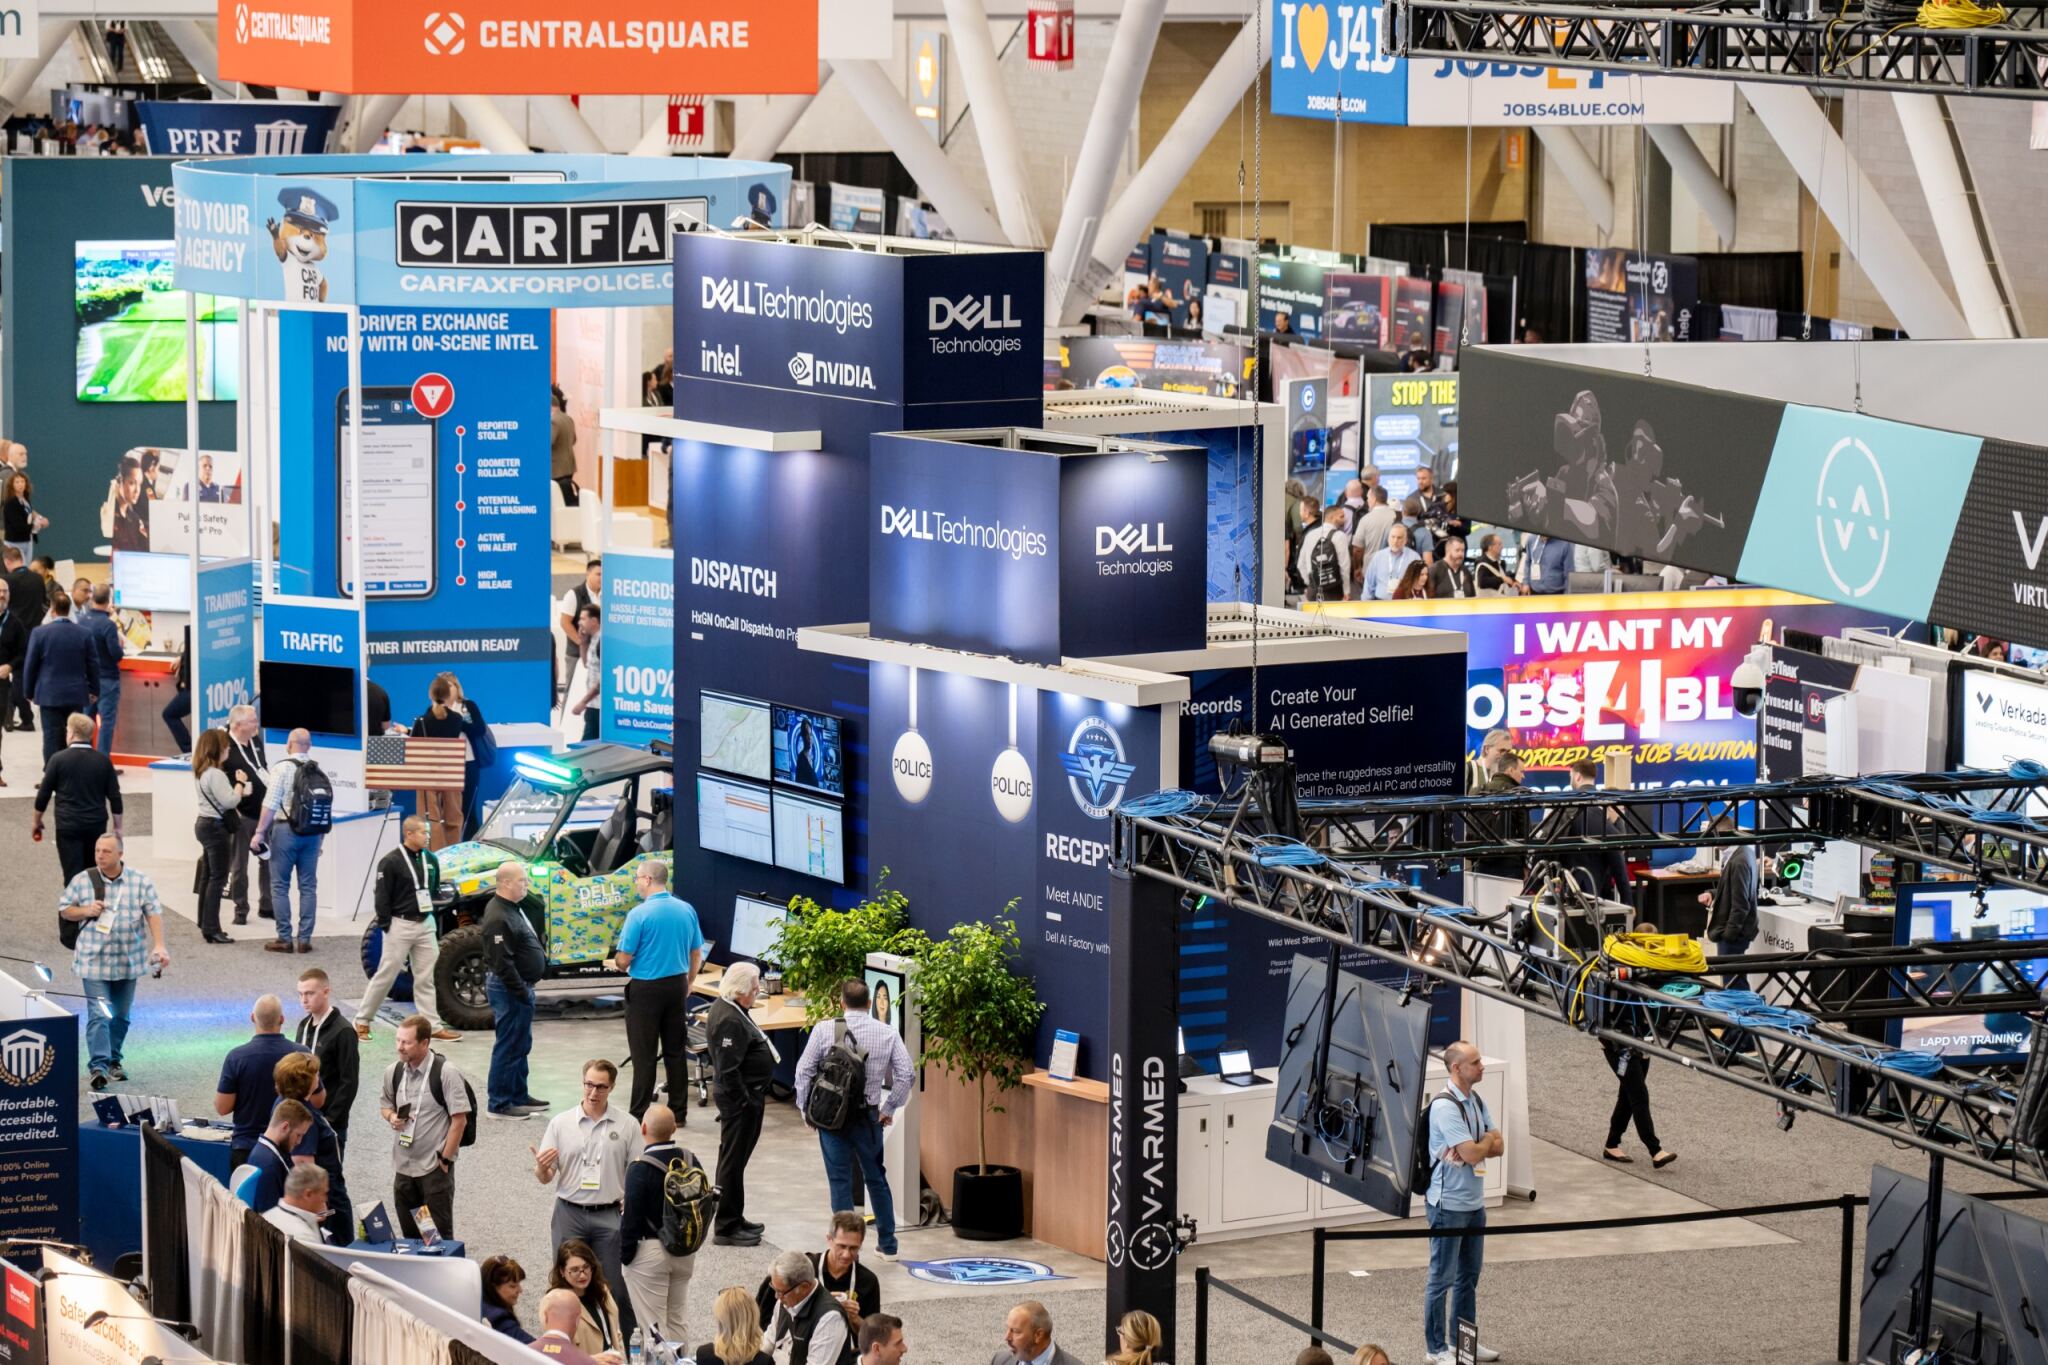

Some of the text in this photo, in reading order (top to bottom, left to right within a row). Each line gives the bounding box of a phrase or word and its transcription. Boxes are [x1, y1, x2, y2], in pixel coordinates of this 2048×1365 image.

[251, 11, 331, 46] CENTRALSQUARE
[480, 20, 750, 54] CENTRALSQUARE
[1503, 103, 1645, 117] JOBS4BLUE.COM
[167, 127, 242, 155] PERF
[184, 199, 249, 235] TO YOUR
[184, 237, 246, 273] AGENCY
[702, 276, 873, 334] DELL Technologies
[928, 294, 1022, 331] DELL
[422, 313, 509, 332] EXCHANGE
[1678, 309, 1691, 339] help
[367, 334, 407, 352] WITH
[412, 334, 492, 352] ON-SCENE
[495, 334, 538, 351] INTEL
[928, 335, 1022, 356] Technologies
[1392, 380, 1456, 406] STOP THE
[477, 421, 518, 431] REPORTED
[477, 431, 508, 440] STOLEN
[477, 459, 520, 468] ODOMETER
[477, 468, 519, 478] ROLLBACK
[477, 496, 520, 505] POTENTIAL
[477, 505, 537, 515] TITLE WASHING
[477, 533, 505, 542] ACTIVE
[881, 504, 1047, 560] DELL Technologies
[1095, 522, 1173, 555] DELL
[493, 542, 517, 552] ALERT
[477, 571, 497, 580] HIGH
[691, 556, 777, 599] DISPATCH
[1096, 558, 1173, 576] Technologies
[477, 580, 512, 590] MILEAGE
[204, 589, 247, 614] TRAINING
[691, 609, 713, 627] HxGN
[714, 613, 739, 632] OnCall
[740, 618, 773, 637] Dispatch
[775, 628, 785, 640] on
[1513, 616, 1732, 654] I WANT MY
[280, 630, 343, 654] TRAFFIC
[402, 639, 479, 654] INTEGRATION
[483, 638, 520, 651] READY
[612, 664, 674, 699] 100%
[206, 677, 249, 713] 100%
[613, 697, 641, 712] Time
[1180, 694, 1242, 716] Records
[1270, 685, 1357, 707] Create Your
[1270, 705, 1414, 731] AI Generated Selfie!
[1999, 697, 2047, 726] Verkada
[1635, 742, 1673, 764] JOB
[1674, 739, 1757, 763] SOLUTION
[894, 757, 932, 779] POLICE
[1322, 769, 1337, 781] the
[1338, 766, 1392, 781] ruggedness
[1394, 763, 1411, 775] and
[1413, 760, 1457, 774] versatility
[992, 776, 1032, 798] POLICE
[1298, 777, 1453, 798] Dell Pro Rugged AI PC and choose
[579, 882, 620, 900] DELL
[580, 895, 621, 909] RUGGED
[1046, 885, 1103, 912] Meet ANDIE
[1045, 930, 1059, 944] Dell
[1068, 935, 1094, 954] Factory
[1268, 937, 1283, 948] Wild
[1284, 936, 1301, 947] West
[1763, 930, 1794, 953] Verkada
[1356, 959, 1370, 967] about
[1920, 1032, 2023, 1048] LAPD VR TRAINING
[1112, 1053, 1122, 1216] V-ARMED
[1141, 1056, 1165, 1221] V-ARMED
[23, 1161, 50, 1169] Online
[21, 1172, 60, 1182] Programs
[2, 1192, 48, 1203] No Cost for
[21, 1203, 59, 1213] Materials
